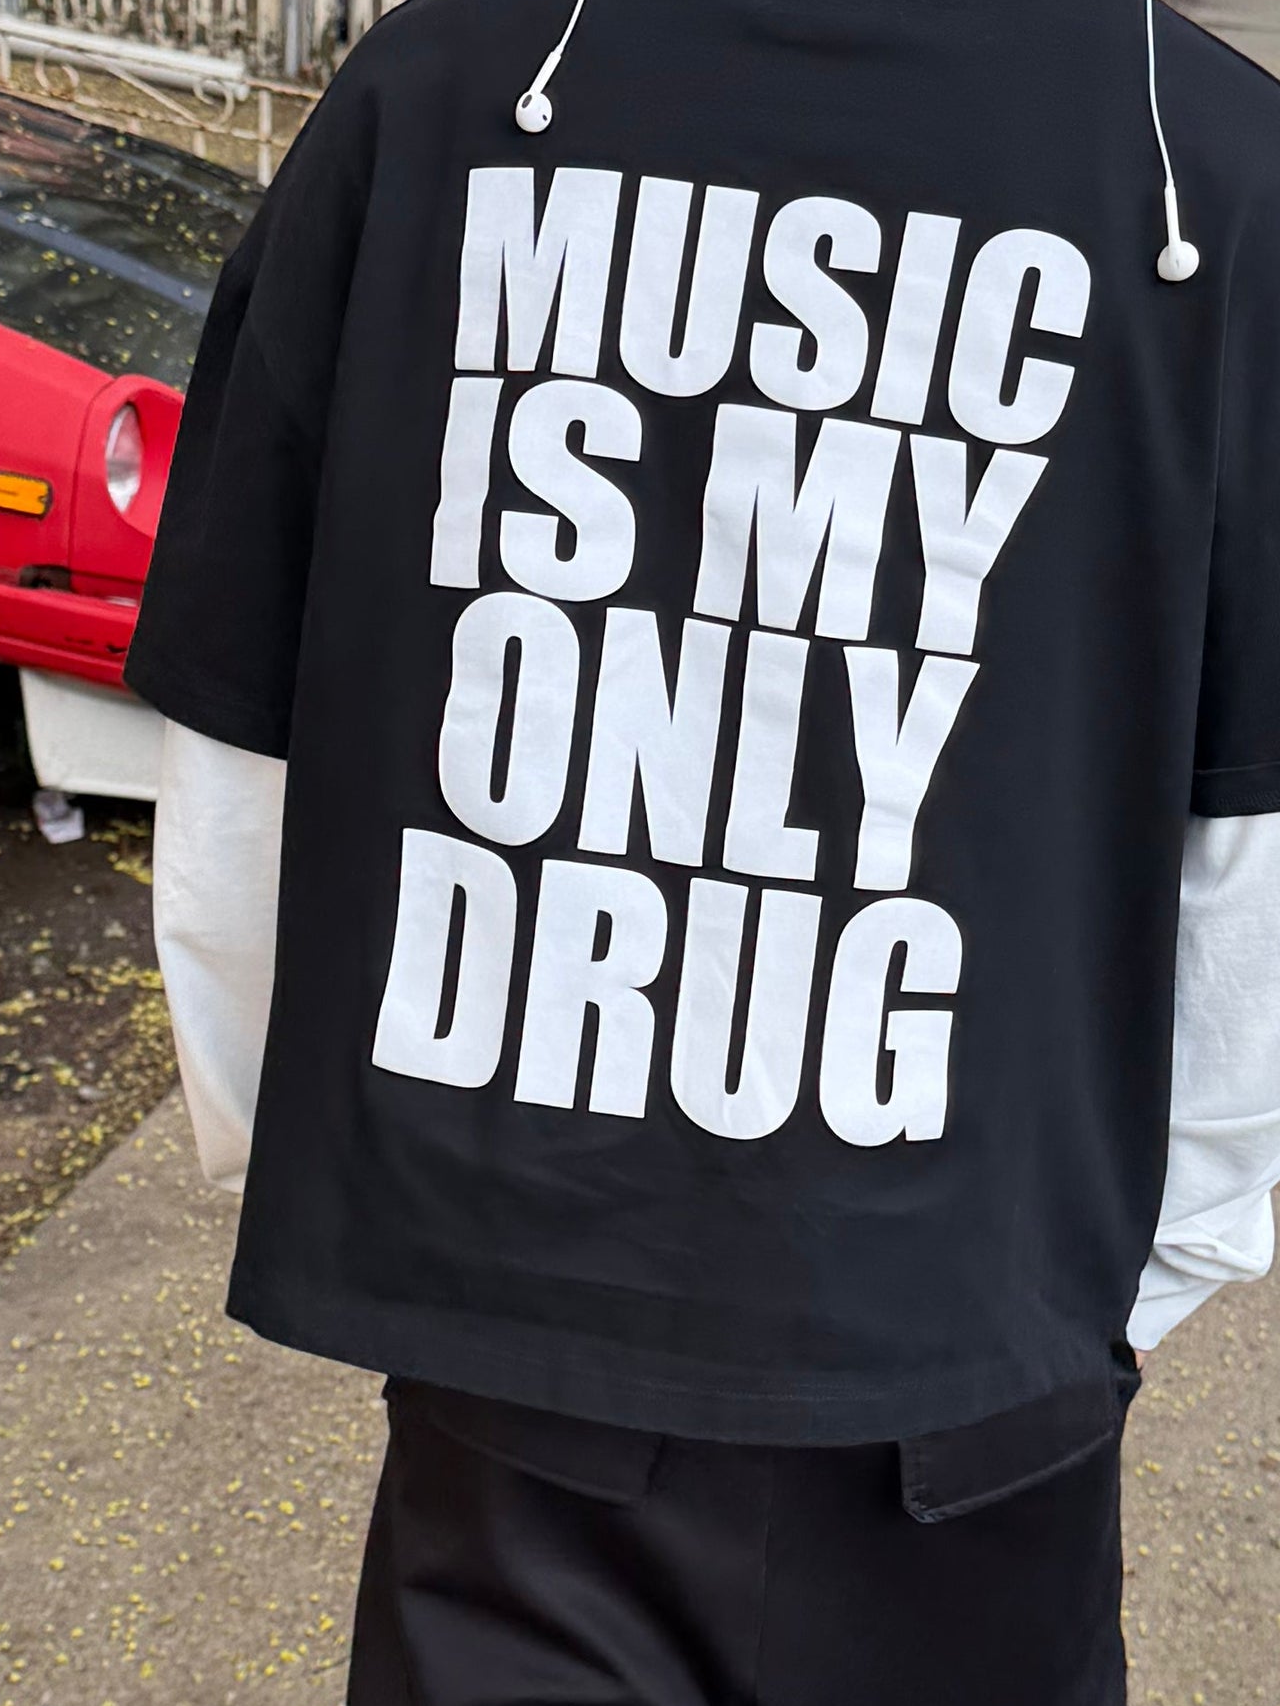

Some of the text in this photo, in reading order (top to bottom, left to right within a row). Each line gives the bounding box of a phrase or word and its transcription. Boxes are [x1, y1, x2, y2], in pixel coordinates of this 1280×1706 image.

[455, 166, 1091, 445] MUSIC
[430, 377, 1049, 656] IS MY
[439, 591, 980, 891] ONLY
[372, 827, 962, 1147] DRUG
